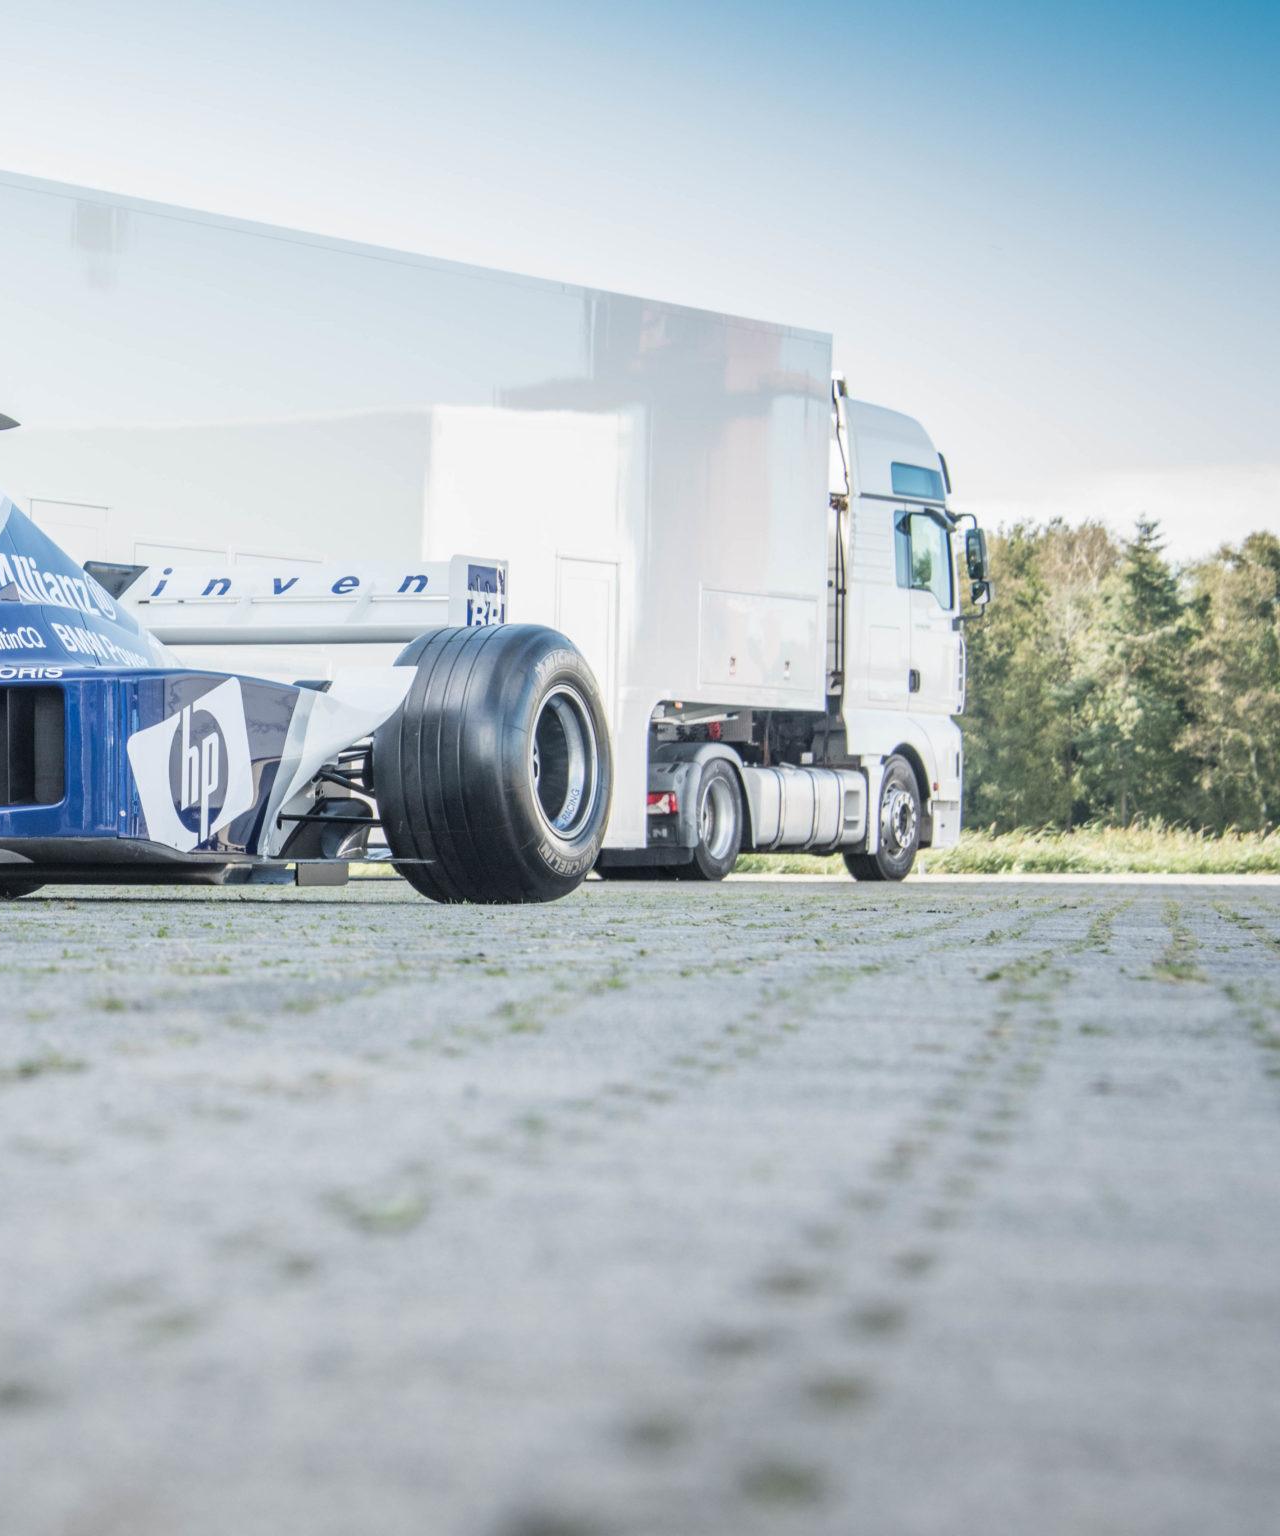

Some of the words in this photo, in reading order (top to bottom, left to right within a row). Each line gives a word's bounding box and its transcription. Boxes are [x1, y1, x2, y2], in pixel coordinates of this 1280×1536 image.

[51, 622, 108, 660] BMW
[181, 702, 219, 853] hp
[562, 787, 580, 824] RACING
[540, 843, 593, 875] MICHELIN
